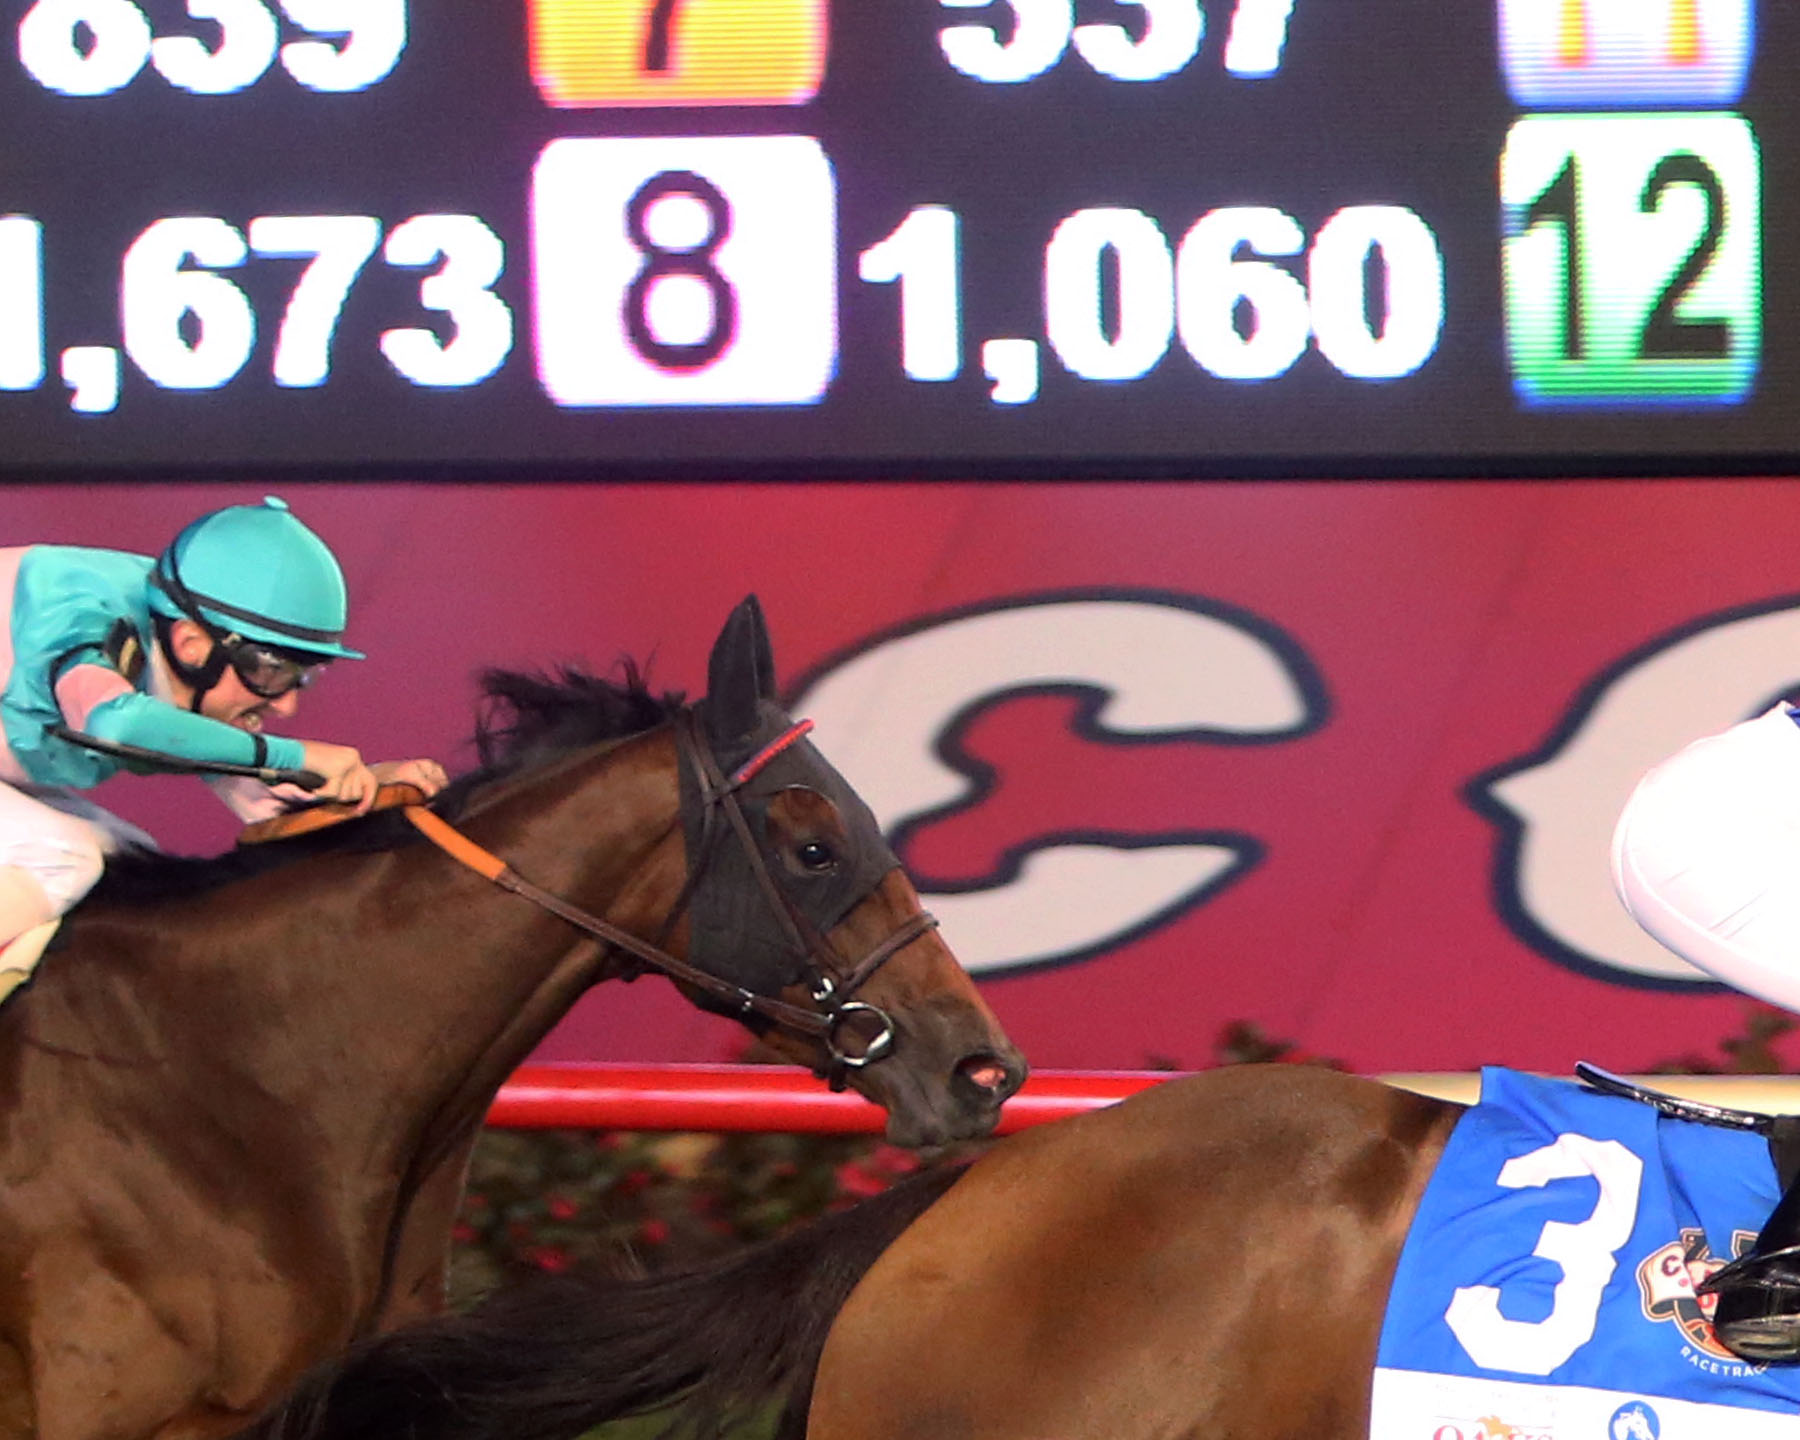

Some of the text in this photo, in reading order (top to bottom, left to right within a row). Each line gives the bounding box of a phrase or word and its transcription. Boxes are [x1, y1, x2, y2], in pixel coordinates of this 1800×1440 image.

[622, 169, 740, 377] 8
[859, 205, 1446, 404] 1,060
[1515, 148, 1735, 361] 12
[1445, 1132, 1642, 1375] 3
